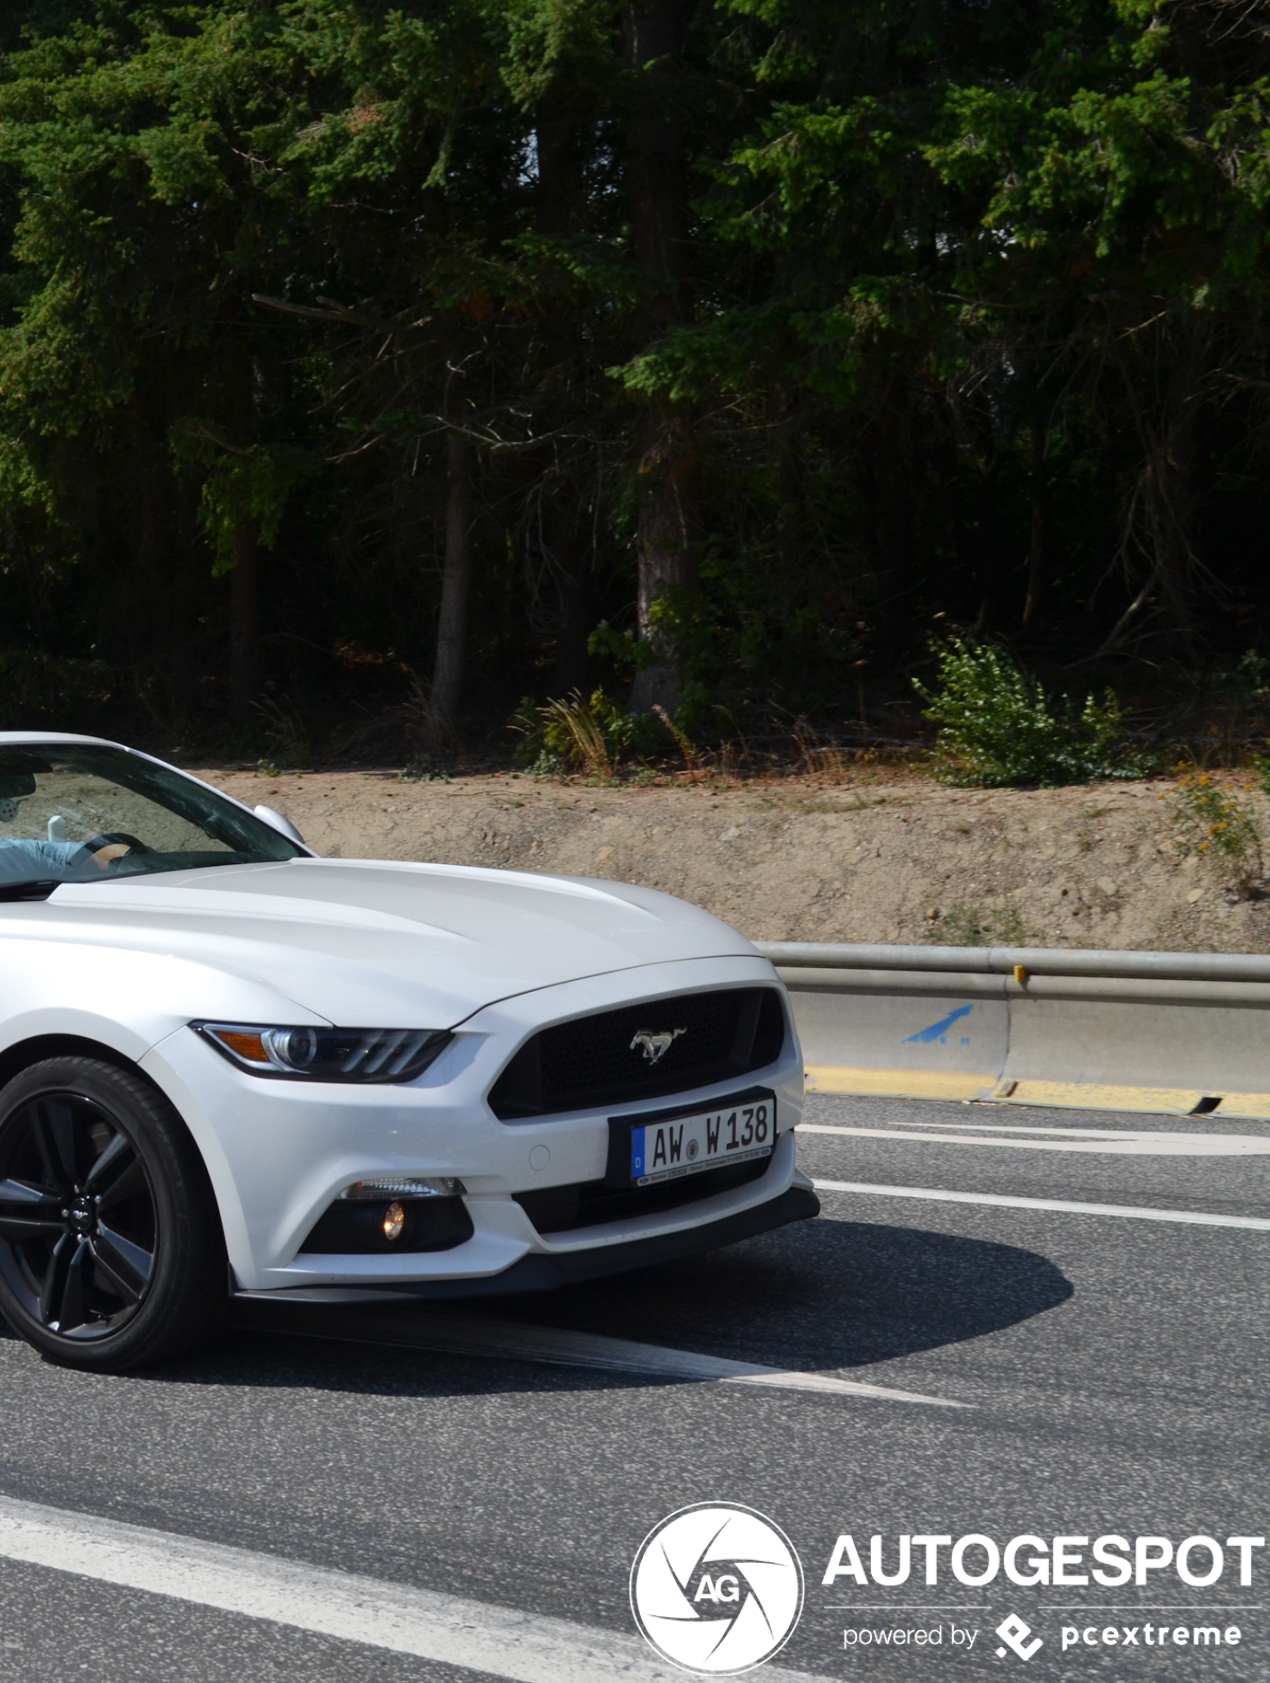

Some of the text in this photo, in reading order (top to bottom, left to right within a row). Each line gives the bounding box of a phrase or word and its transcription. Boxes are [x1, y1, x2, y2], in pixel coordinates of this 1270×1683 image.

[652, 1105, 768, 1168] AW W 138
[635, 1157, 641, 1168] D
